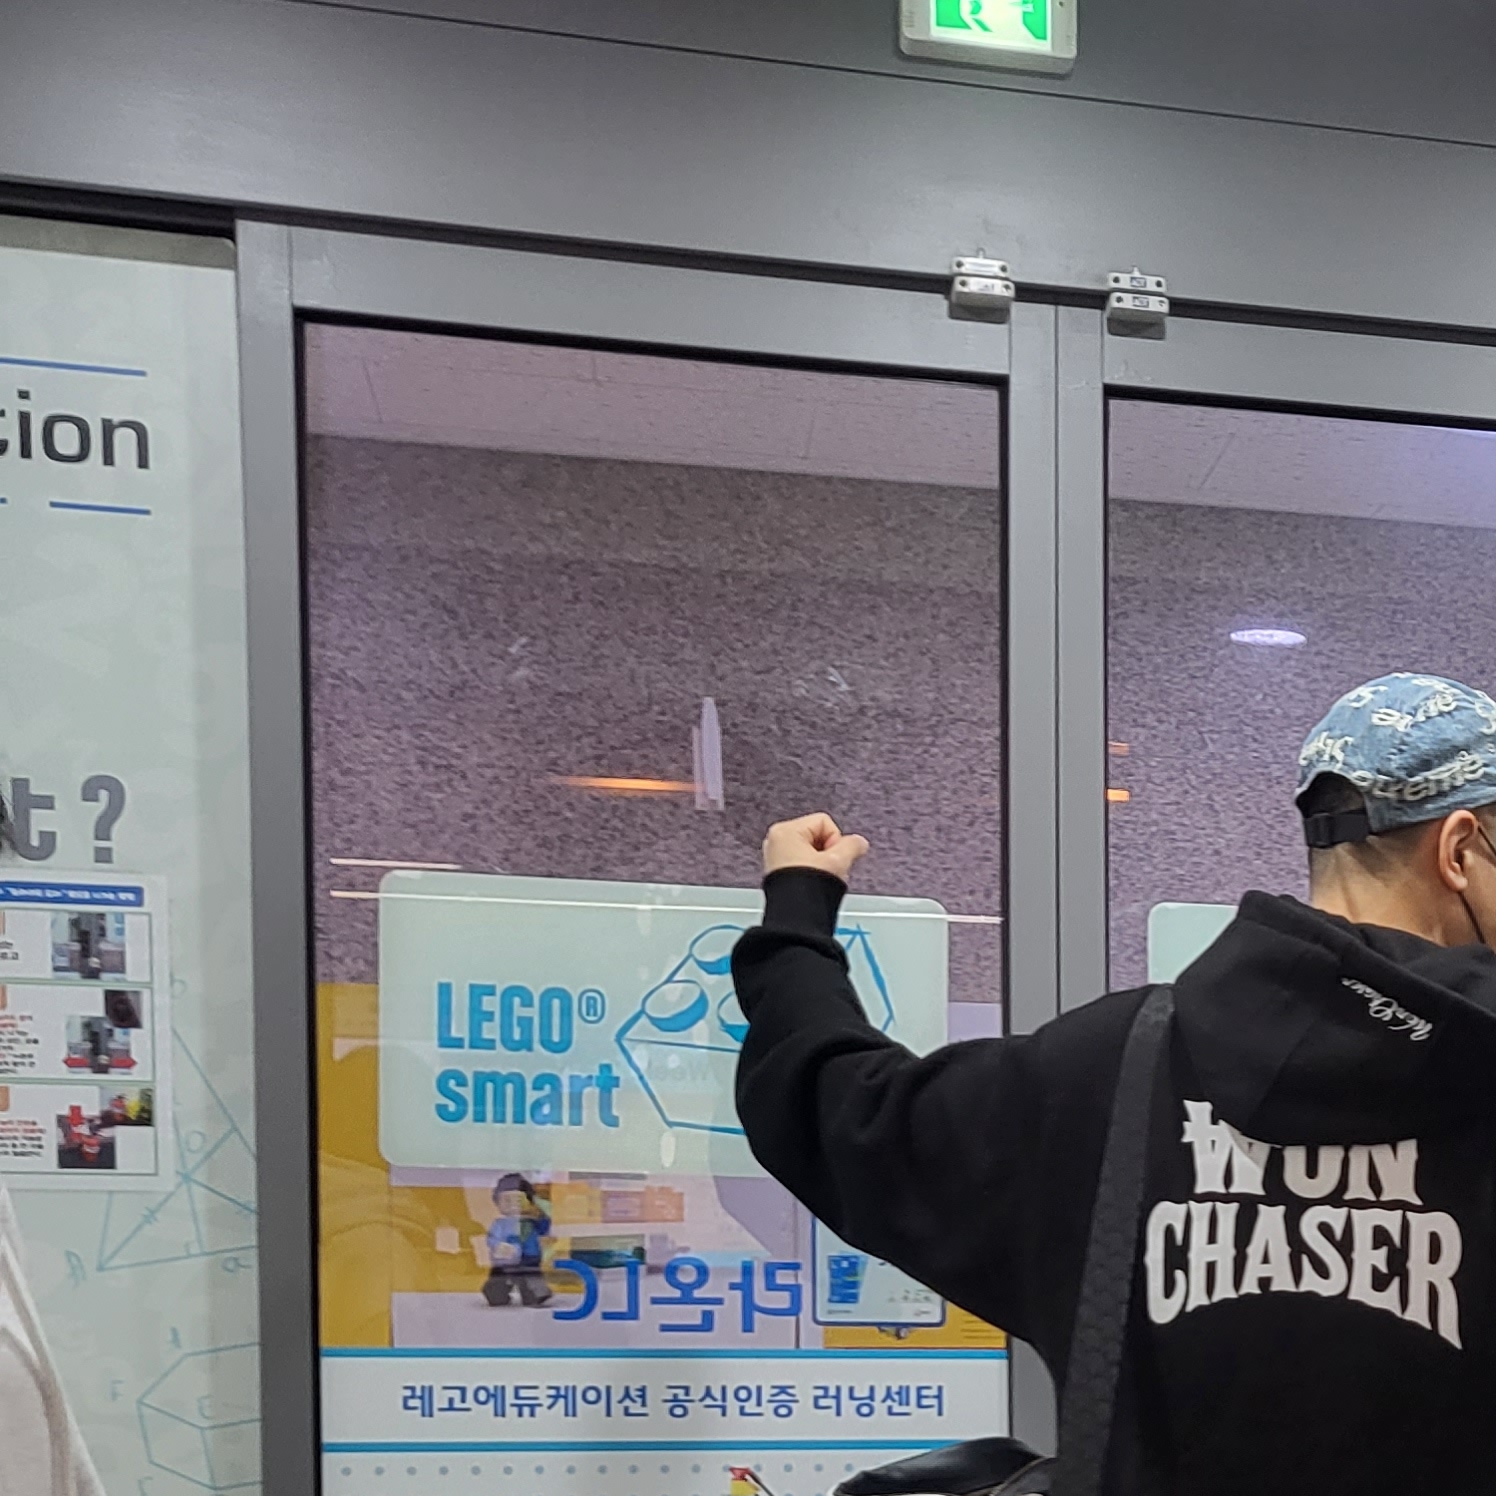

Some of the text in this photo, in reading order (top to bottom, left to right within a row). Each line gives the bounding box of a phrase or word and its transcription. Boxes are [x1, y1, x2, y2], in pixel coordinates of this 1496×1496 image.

[435, 1062, 620, 1128] smart
[1144, 1200, 1463, 1350] CHASER
[402, 1384, 945, 1419] 레고에듀케이션 공식인증 러닝센터
